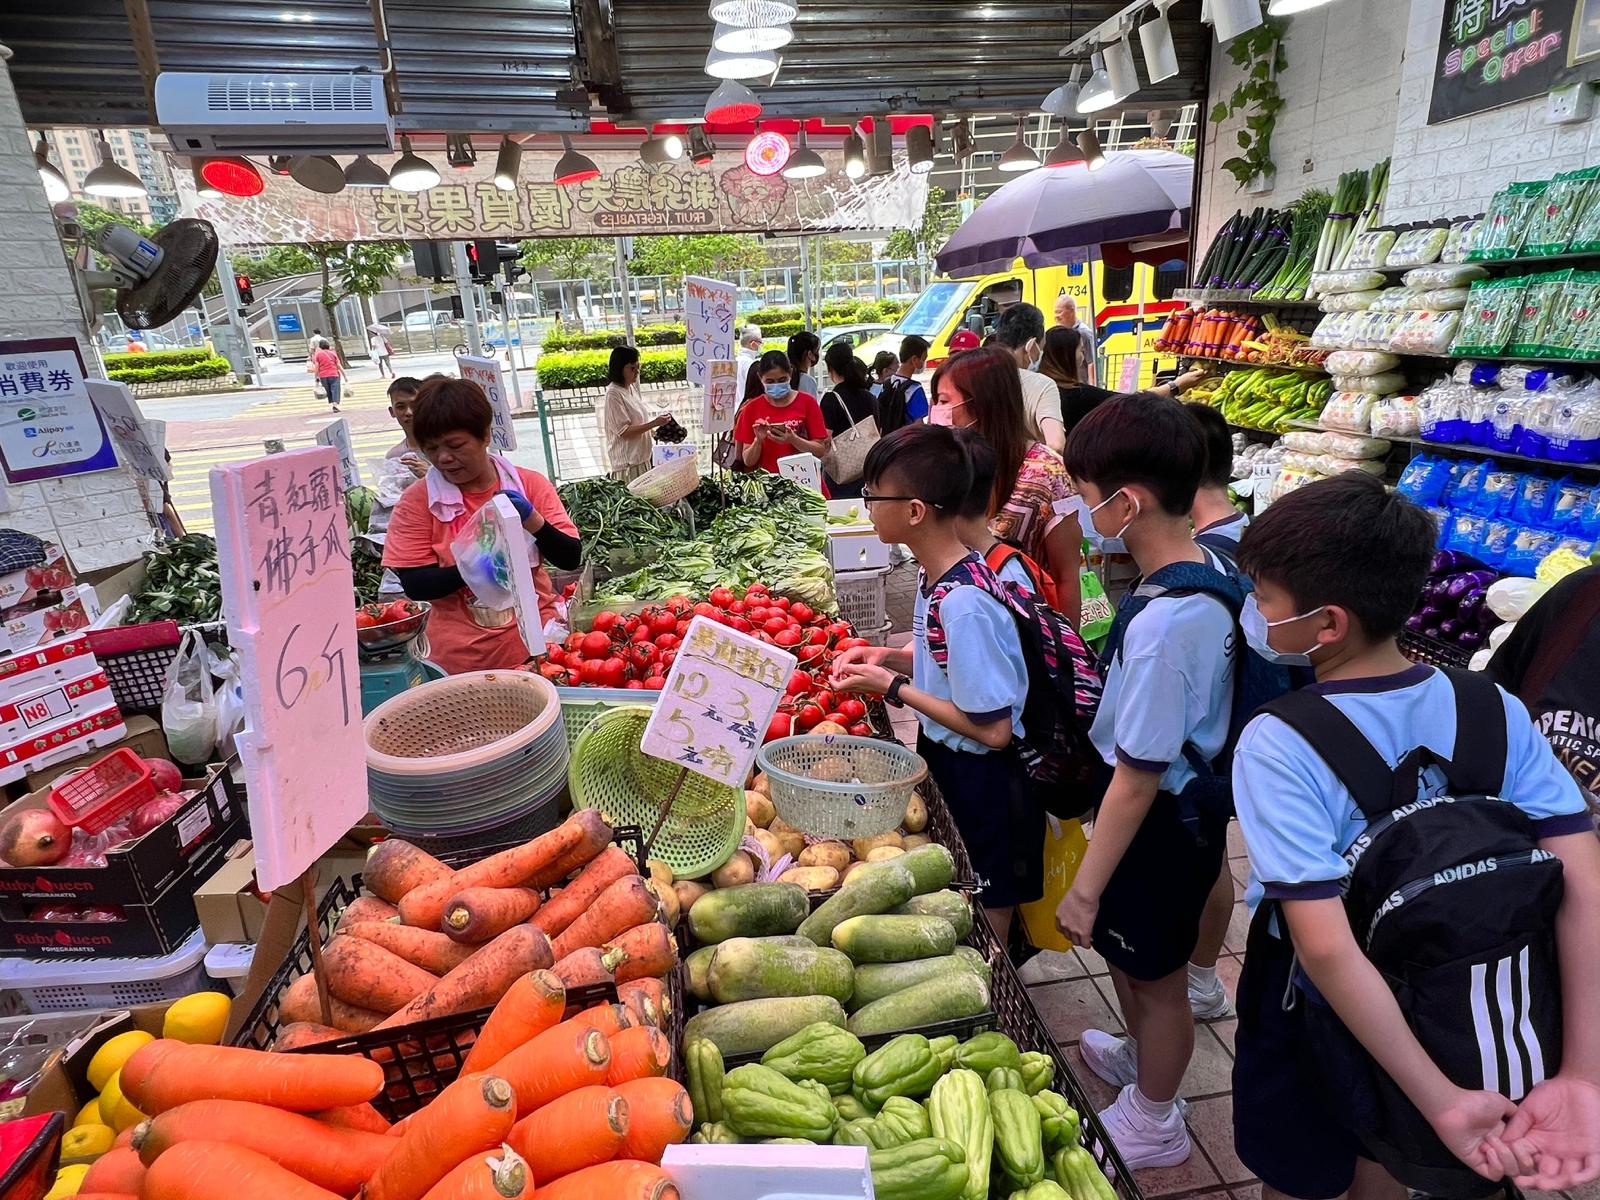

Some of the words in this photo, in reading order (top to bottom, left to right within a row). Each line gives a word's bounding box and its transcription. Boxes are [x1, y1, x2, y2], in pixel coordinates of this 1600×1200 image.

[1444, 9, 1540, 76] Special
[5, 359, 49, 371] 歡迎使用
[23, 702, 48, 724] N8
[1391, 795, 1456, 822] ADIDAS
[1433, 857, 1498, 886] ADIDAS
